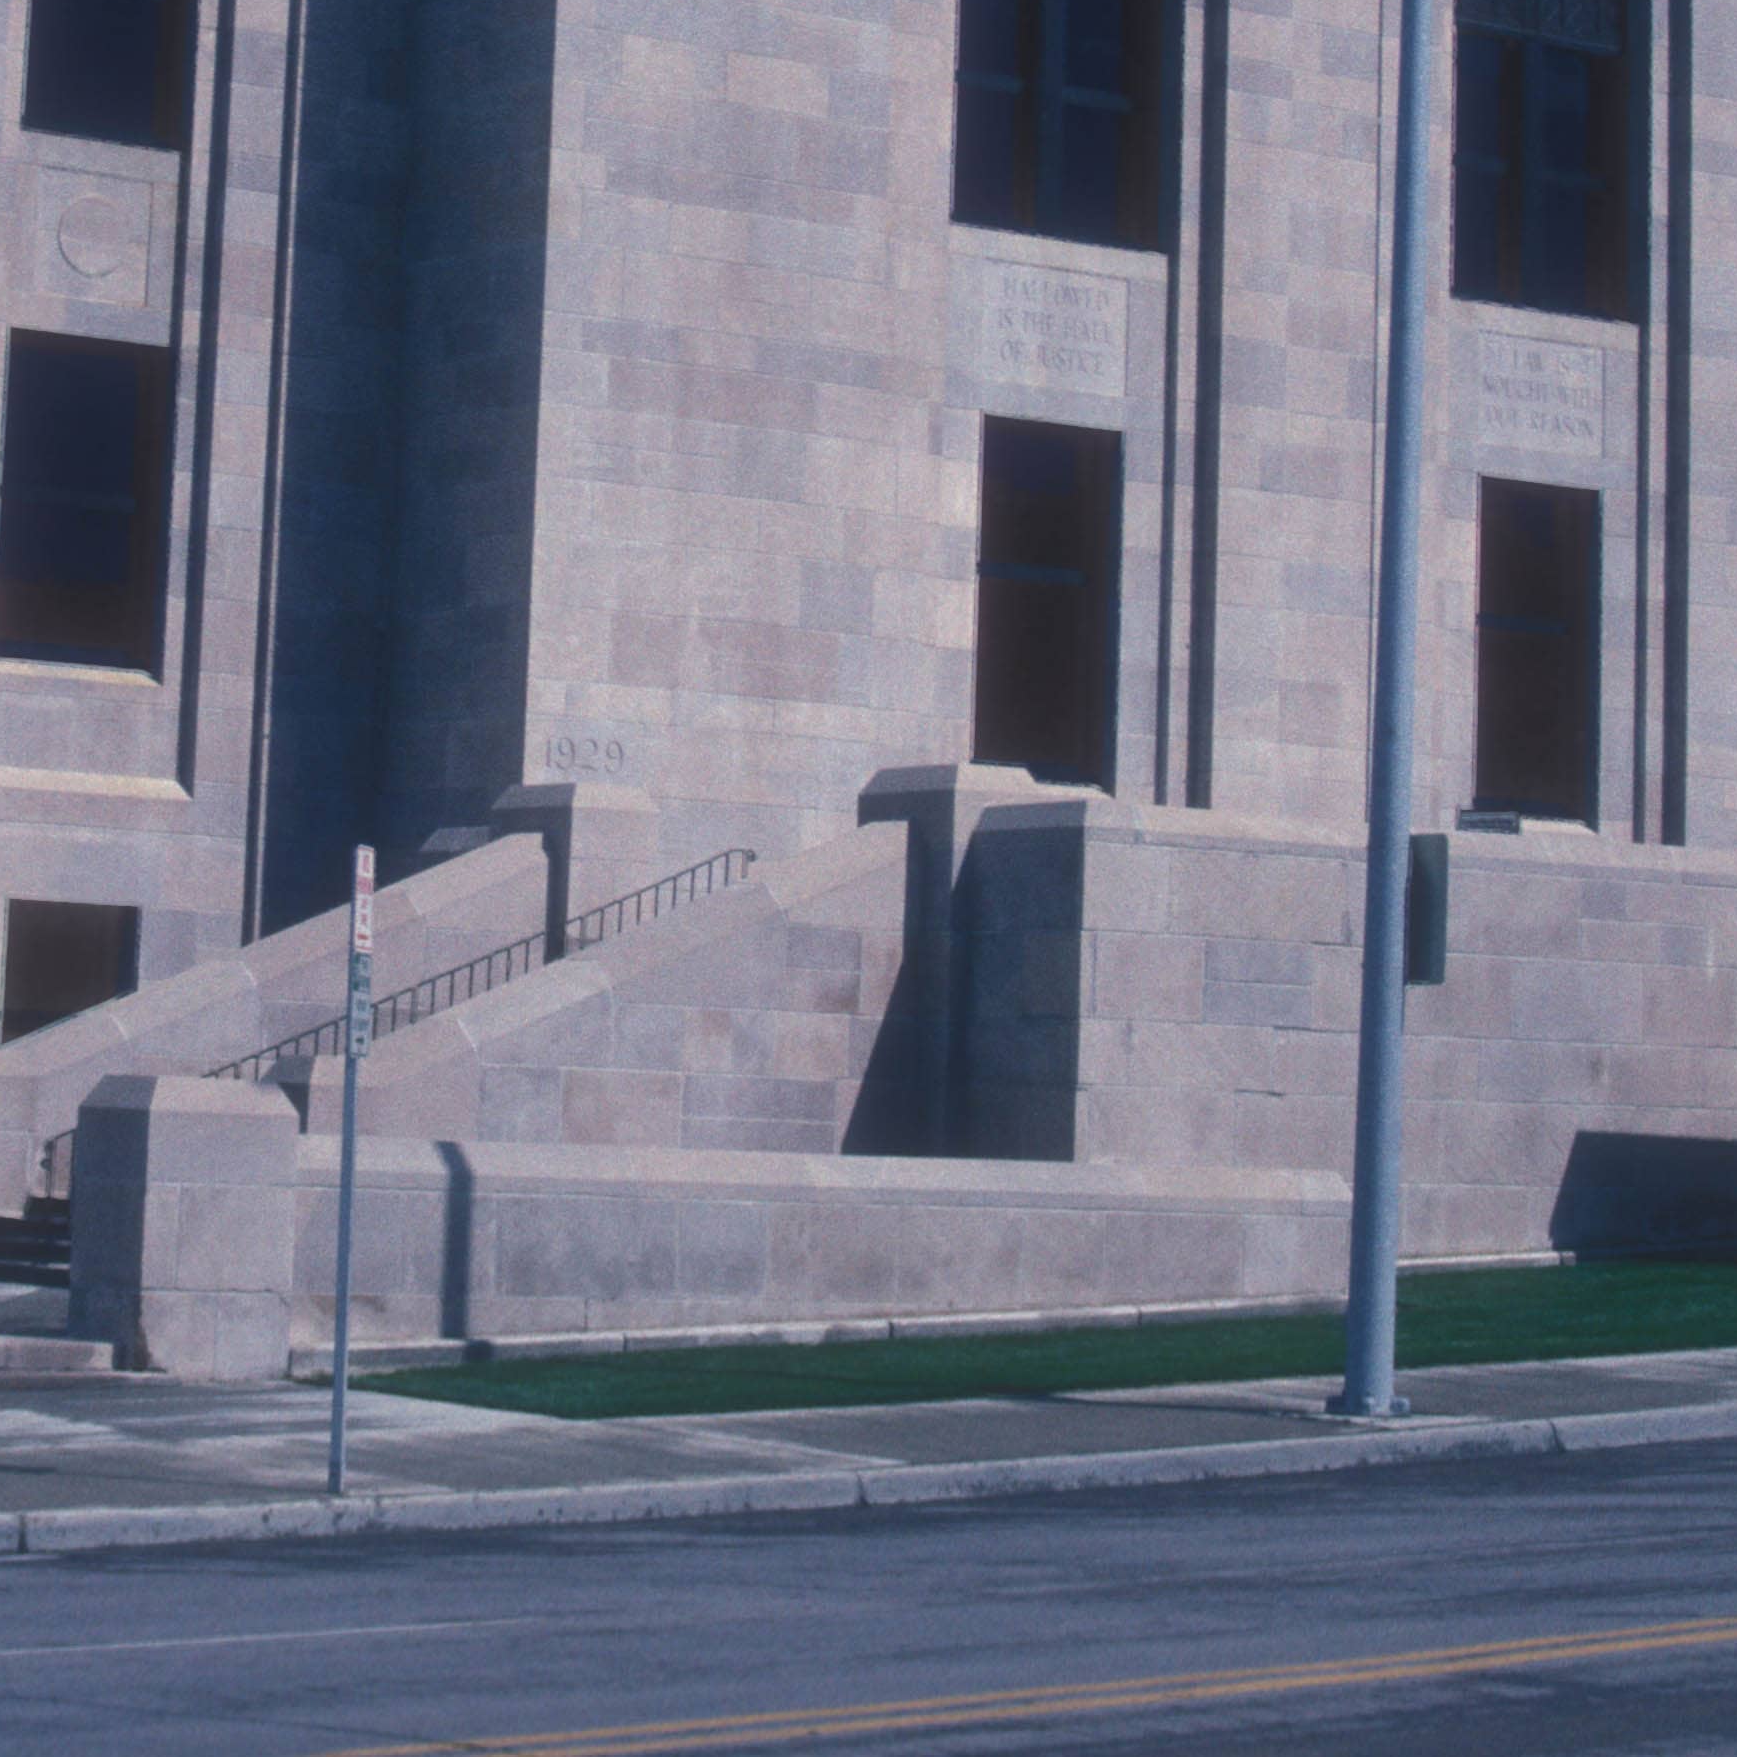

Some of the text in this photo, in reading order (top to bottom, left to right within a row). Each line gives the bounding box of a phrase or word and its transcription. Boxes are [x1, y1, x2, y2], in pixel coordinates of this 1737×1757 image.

[1022, 310, 1054, 335] THE
[1063, 316, 1112, 345] HALL
[1000, 340, 1022, 364] OF
[545, 737, 624, 774] 1929
